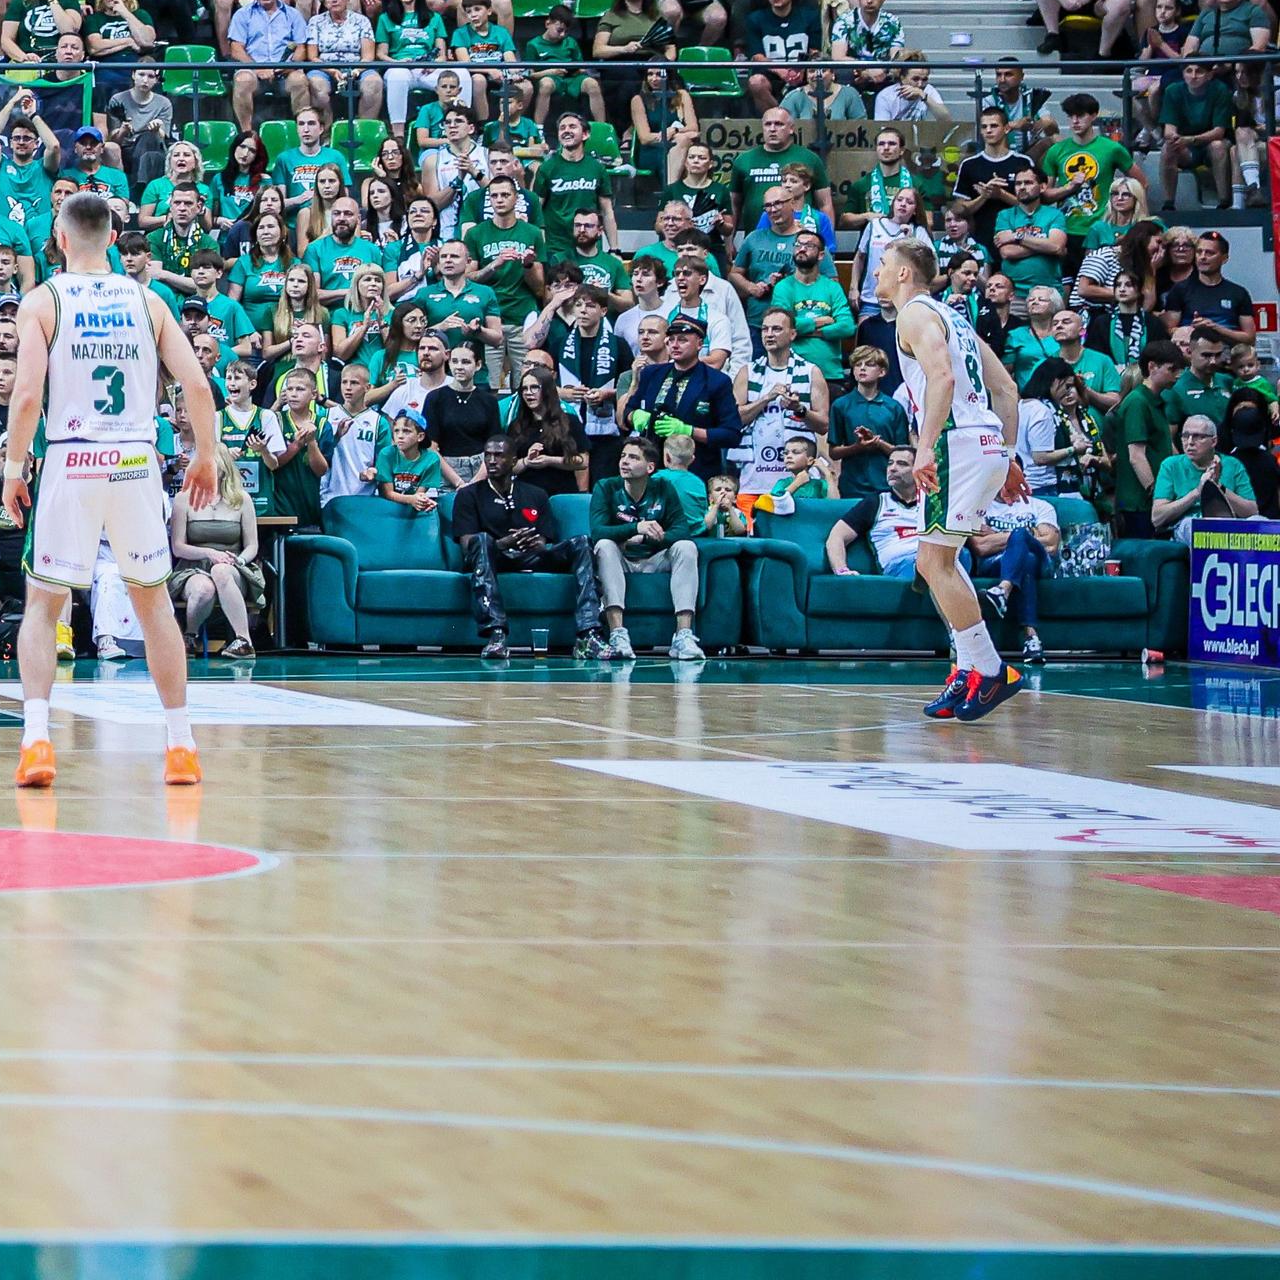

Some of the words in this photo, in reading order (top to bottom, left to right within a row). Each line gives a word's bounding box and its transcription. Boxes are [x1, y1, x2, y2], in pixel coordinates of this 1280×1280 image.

[550, 177, 597, 192] Zastal
[758, 247, 794, 264] ZALGIR
[74, 311, 135, 328] ARPOL
[72, 344, 139, 361] MAZURCZAK
[92, 365, 125, 416] 3
[356, 429, 374, 441] 10
[66, 449, 121, 469] BRICO
[1203, 637, 1260, 660] www.blech.pl
